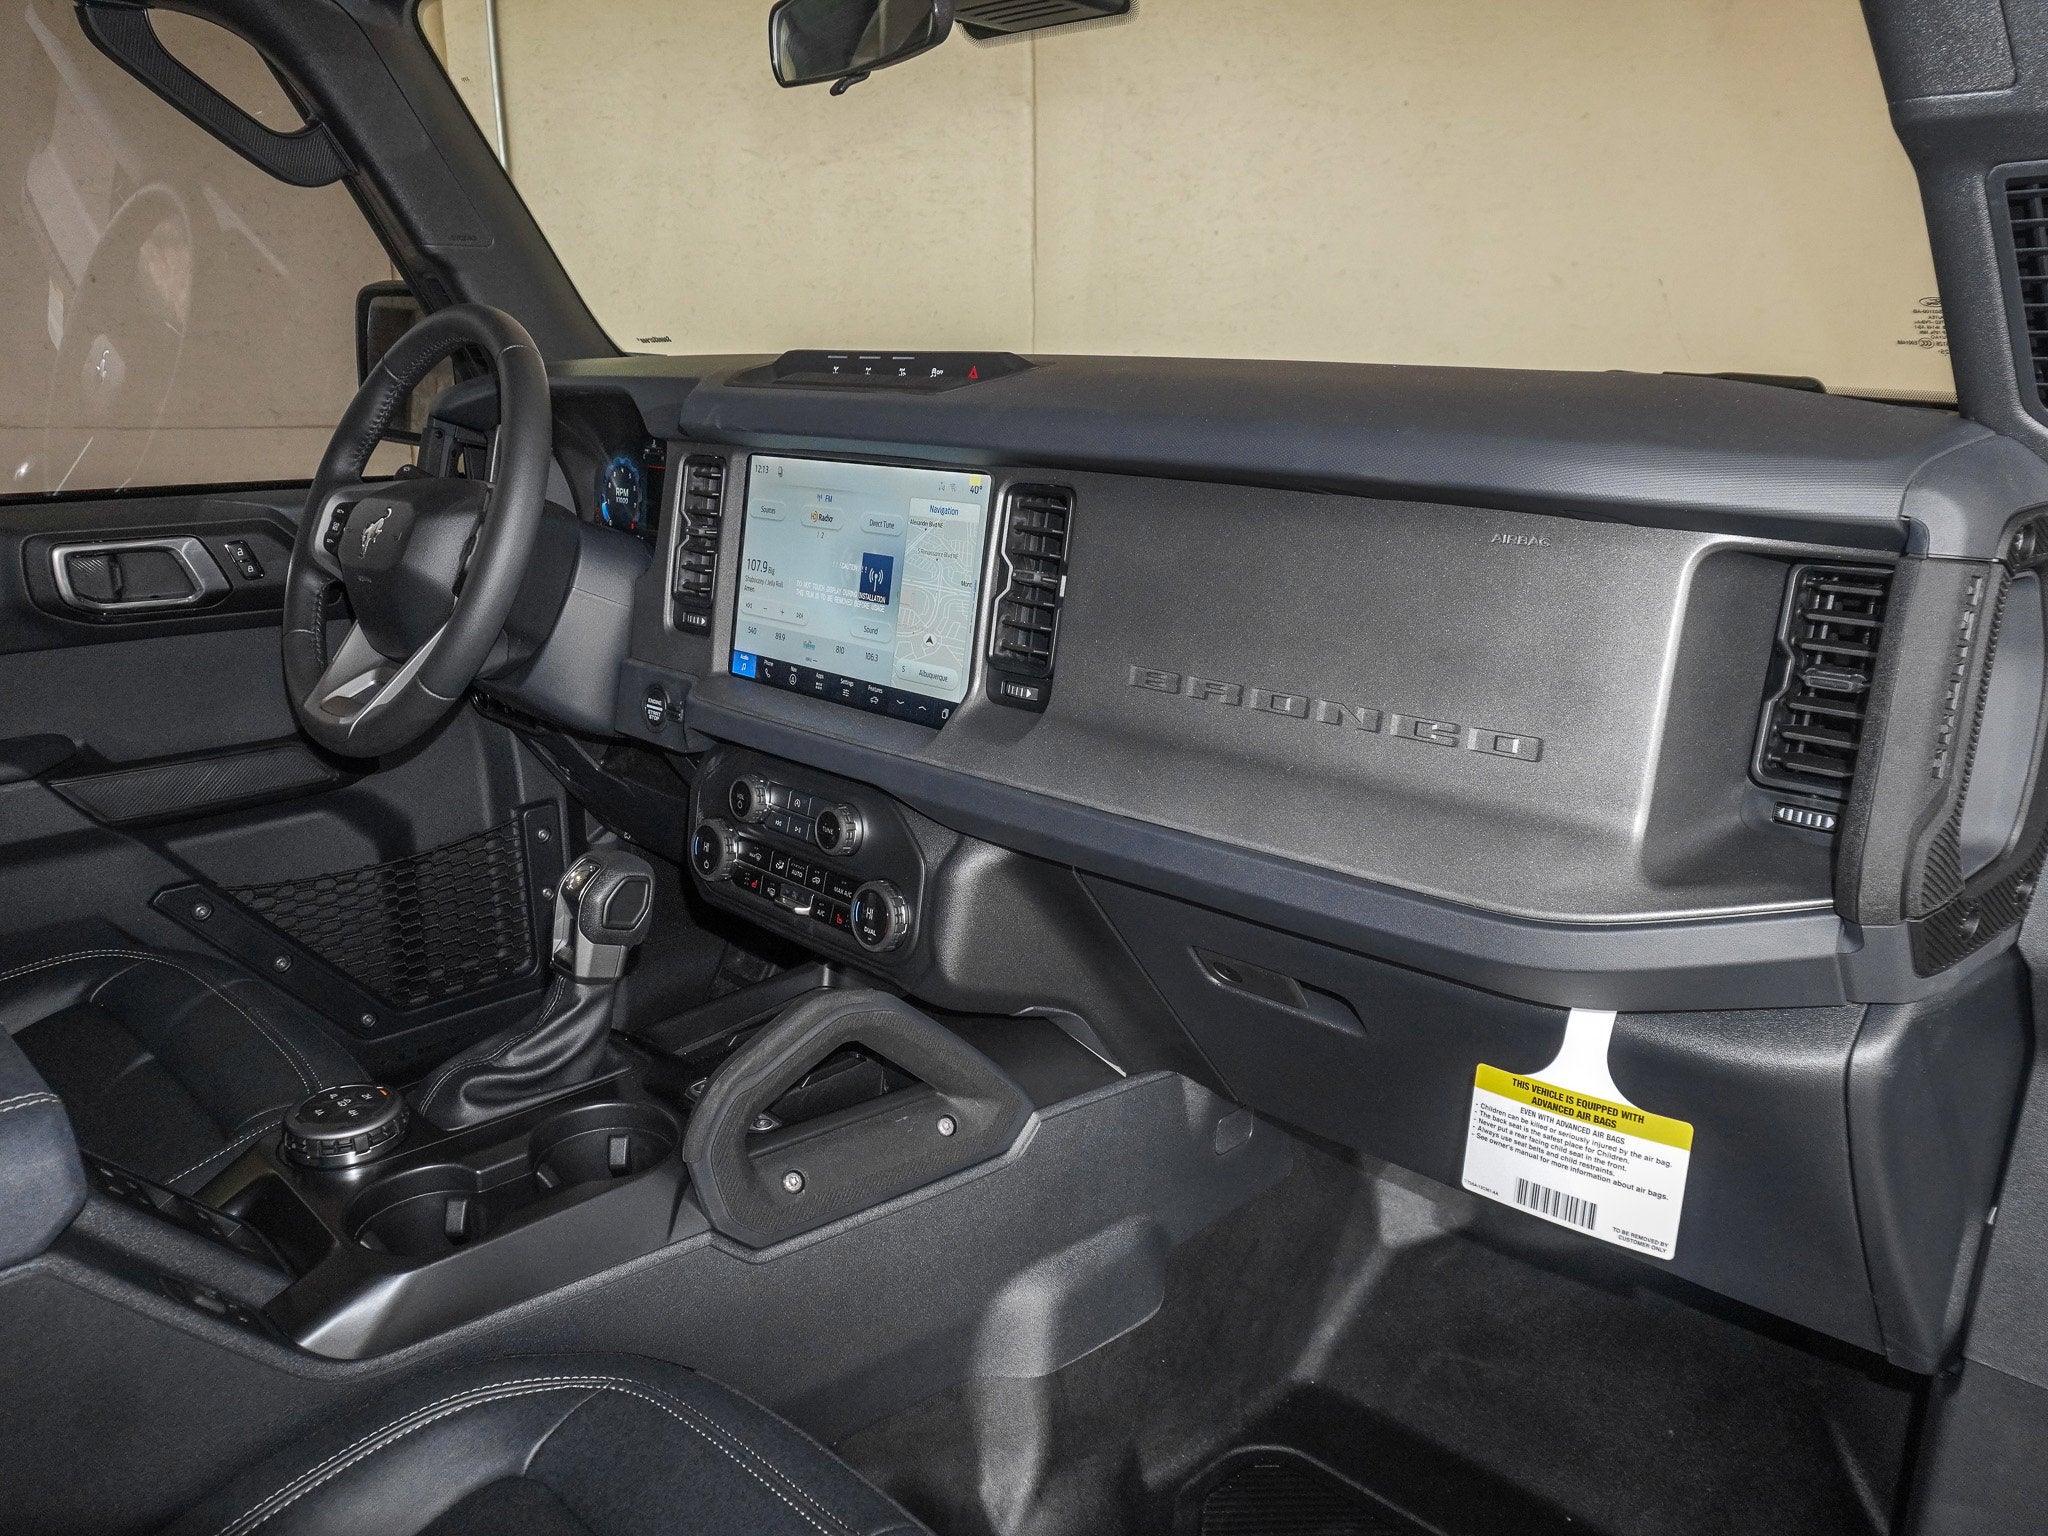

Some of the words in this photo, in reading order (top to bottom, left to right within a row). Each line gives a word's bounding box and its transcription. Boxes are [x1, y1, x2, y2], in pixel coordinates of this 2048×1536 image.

[615, 488, 629, 497] RPM
[824, 494, 833, 503] FM
[929, 504, 959, 516] Navigation
[818, 513, 834, 523] Radio
[869, 518, 881, 528] Direct
[882, 520, 895, 530] Tune
[1491, 533, 1552, 547] AIRBAG
[747, 558, 768, 573] 107.9
[858, 592, 886, 604] INSTALLATION
[748, 626, 757, 635] 540
[863, 625, 879, 635] Sound
[775, 632, 786, 641] 89.9
[835, 645, 845, 655] 810
[865, 652, 879, 662] 106.3
[918, 669, 949, 682] Albuquerque
[840, 677, 854, 688] Settings
[867, 685, 883, 694] Features
[647, 697, 663, 706] ENGINE
[647, 709, 661, 717] START
[1128, 664, 1545, 763] BRONCO
[791, 869, 803, 878] AUTO
[833, 886, 843, 896] MAX
[816, 908, 826, 917] A/C
[863, 926, 877, 937] DUAL
[1512, 1078, 1530, 1091] THIS
[1531, 1083, 1564, 1102] VEHICLE
[1565, 1095, 1575, 1105] IS
[1576, 1099, 1619, 1117] EQUIPPED
[1621, 1110, 1645, 1124] WITH
[1531, 1097, 1574, 1116] ADVANCED
[1576, 1110, 1591, 1122] AIR
[1593, 1115, 1617, 1129] BAGS
[1520, 1107, 1536, 1118] EVEN
[1538, 1112, 1555, 1124] WITH
[1555, 1118, 1591, 1135] ADVANCED
[1592, 1129, 1605, 1138] AIR
[1606, 1133, 1625, 1145] BAGS
[1479, 1110, 1491, 1119] The
[1492, 1113, 1507, 1125] back
[1508, 1121, 1522, 1130] seat
[1523, 1124, 1530, 1132] is
[1530, 1127, 1542, 1137] the
[1542, 1132, 1563, 1144] safest
[1564, 1136, 1583, 1151] place
[1585, 1145, 1595, 1153] for
[1596, 1150, 1630, 1164] Children.
[1480, 1102, 1507, 1117] Children
[1507, 1113, 1520, 1121] can
[1520, 1115, 1529, 1124] be
[1530, 1119, 1548, 1131] killed
[1549, 1126, 1556, 1134] or
[1558, 1130, 1590, 1146] seriously
[1592, 1140, 1617, 1153] injured
[1618, 1148, 1628, 1157] by
[1630, 1150, 1643, 1160] the
[1643, 1154, 1654, 1163] air
[1655, 1158, 1673, 1168] bag.
[1478, 1117, 1497, 1129] Never
[1497, 1124, 1508, 1134] put
[1514, 1130, 1527, 1140] rear
[1528, 1136, 1550, 1149] facing
[1551, 1143, 1567, 1154] child
[1569, 1149, 1583, 1159] seat
[1585, 1154, 1593, 1162] in
[1593, 1156, 1606, 1166] the
[1607, 1160, 1627, 1172] front.
[1477, 1125, 1500, 1138] Always
[1500, 1135, 1513, 1143] use
[1513, 1139, 1527, 1148] seat
[1528, 1142, 1545, 1155] belts
[1546, 1151, 1560, 1162] and
[1560, 1155, 1577, 1167] child
[1578, 1160, 1616, 1177] restraints.
[1476, 1132, 1488, 1142] See
[1490, 1138, 1514, 1152] owner's
[1515, 1146, 1539, 1161] manual
[1540, 1155, 1550, 1164] for
[1551, 1159, 1569, 1170] more
[1570, 1164, 1611, 1184] information
[1612, 1179, 1634, 1191] about
[1635, 1185, 1646, 1195] air
[1647, 1190, 1669, 1201] bags.
[1618, 1235, 1651, 1249] CUSTOMER
[1651, 1245, 1667, 1254] ONLY
[1630, 1233, 1660, 1245] REMOVED
